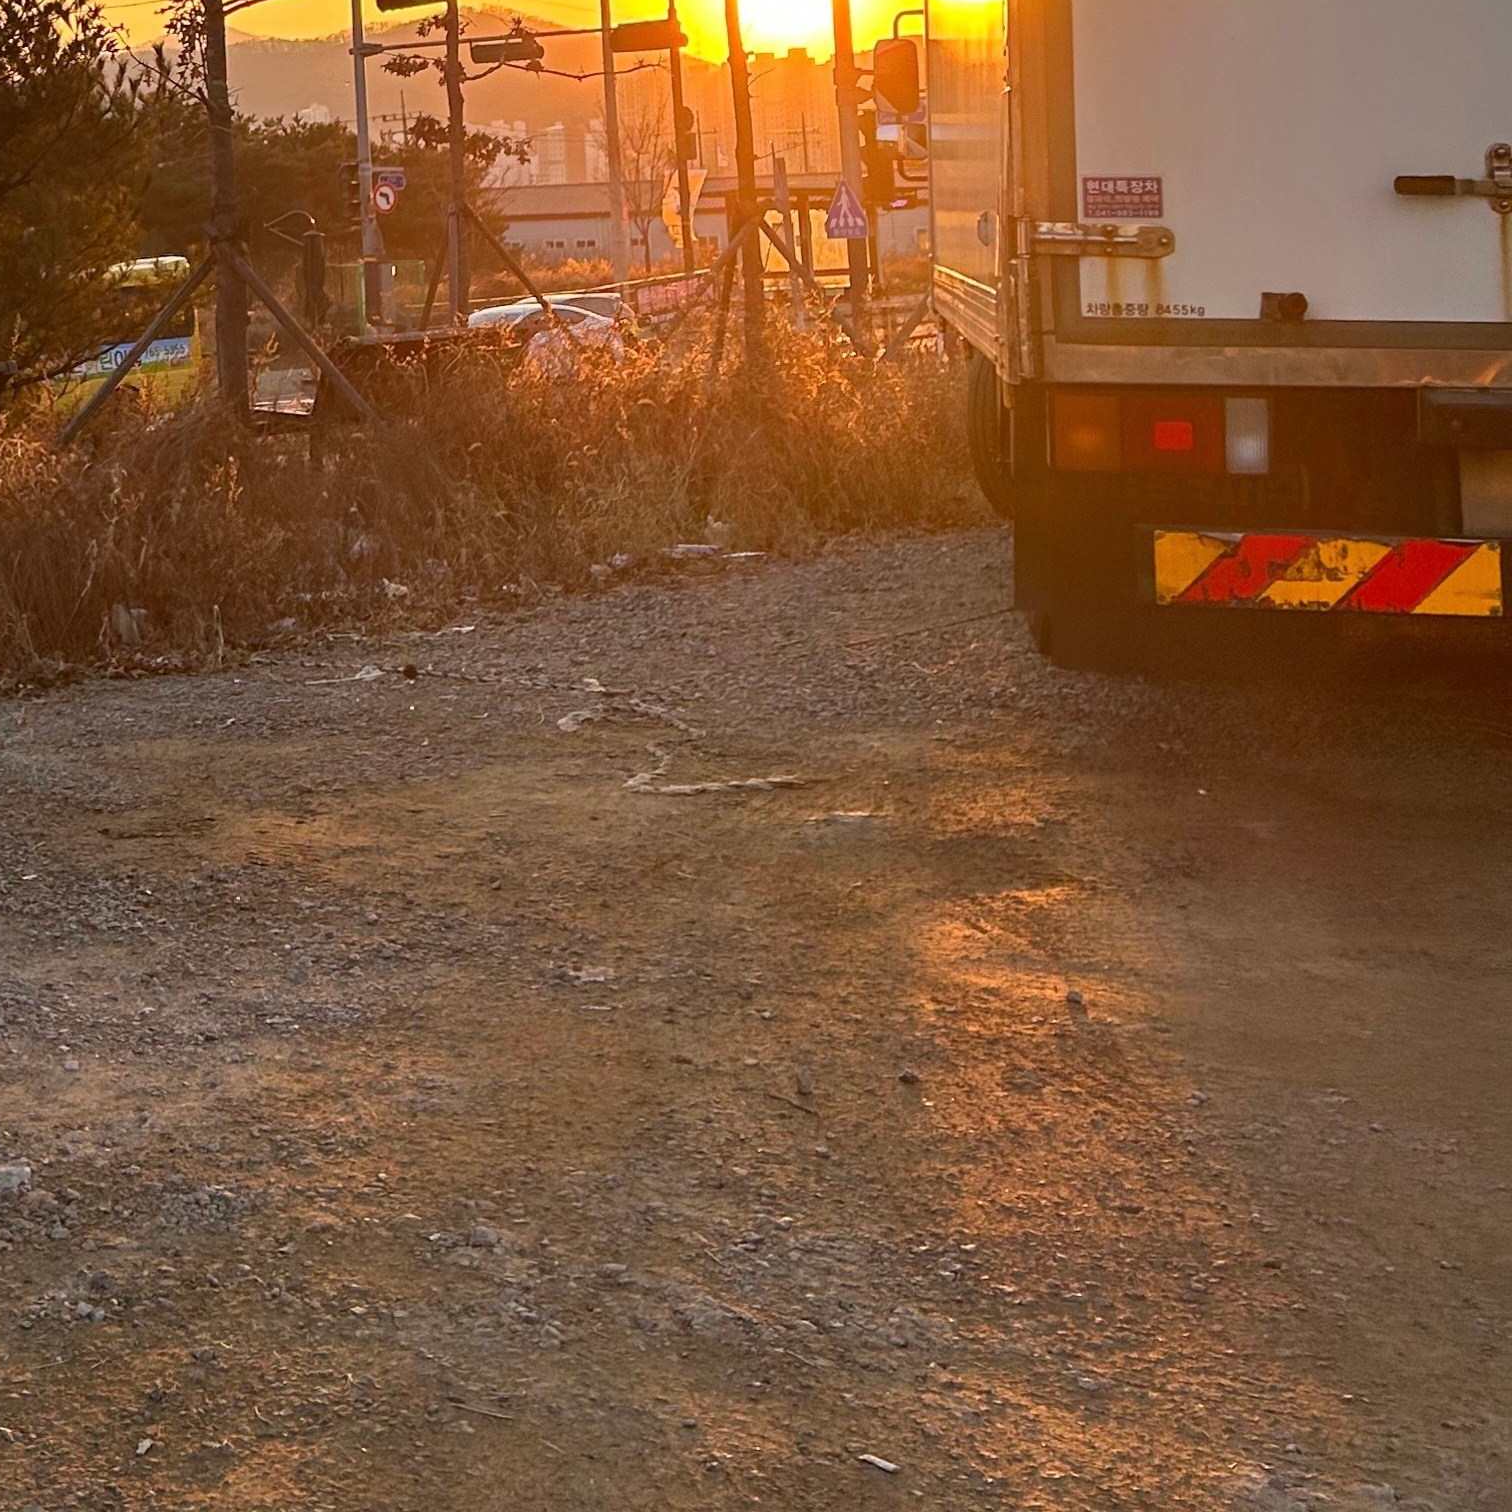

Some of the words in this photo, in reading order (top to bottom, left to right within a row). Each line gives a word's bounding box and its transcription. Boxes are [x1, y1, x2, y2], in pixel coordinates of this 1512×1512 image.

[1086, 180, 1158, 194] 현대특장차
[1086, 303, 1149, 317] 차량총중량
[1155, 304, 1206, 317] 8455kg
